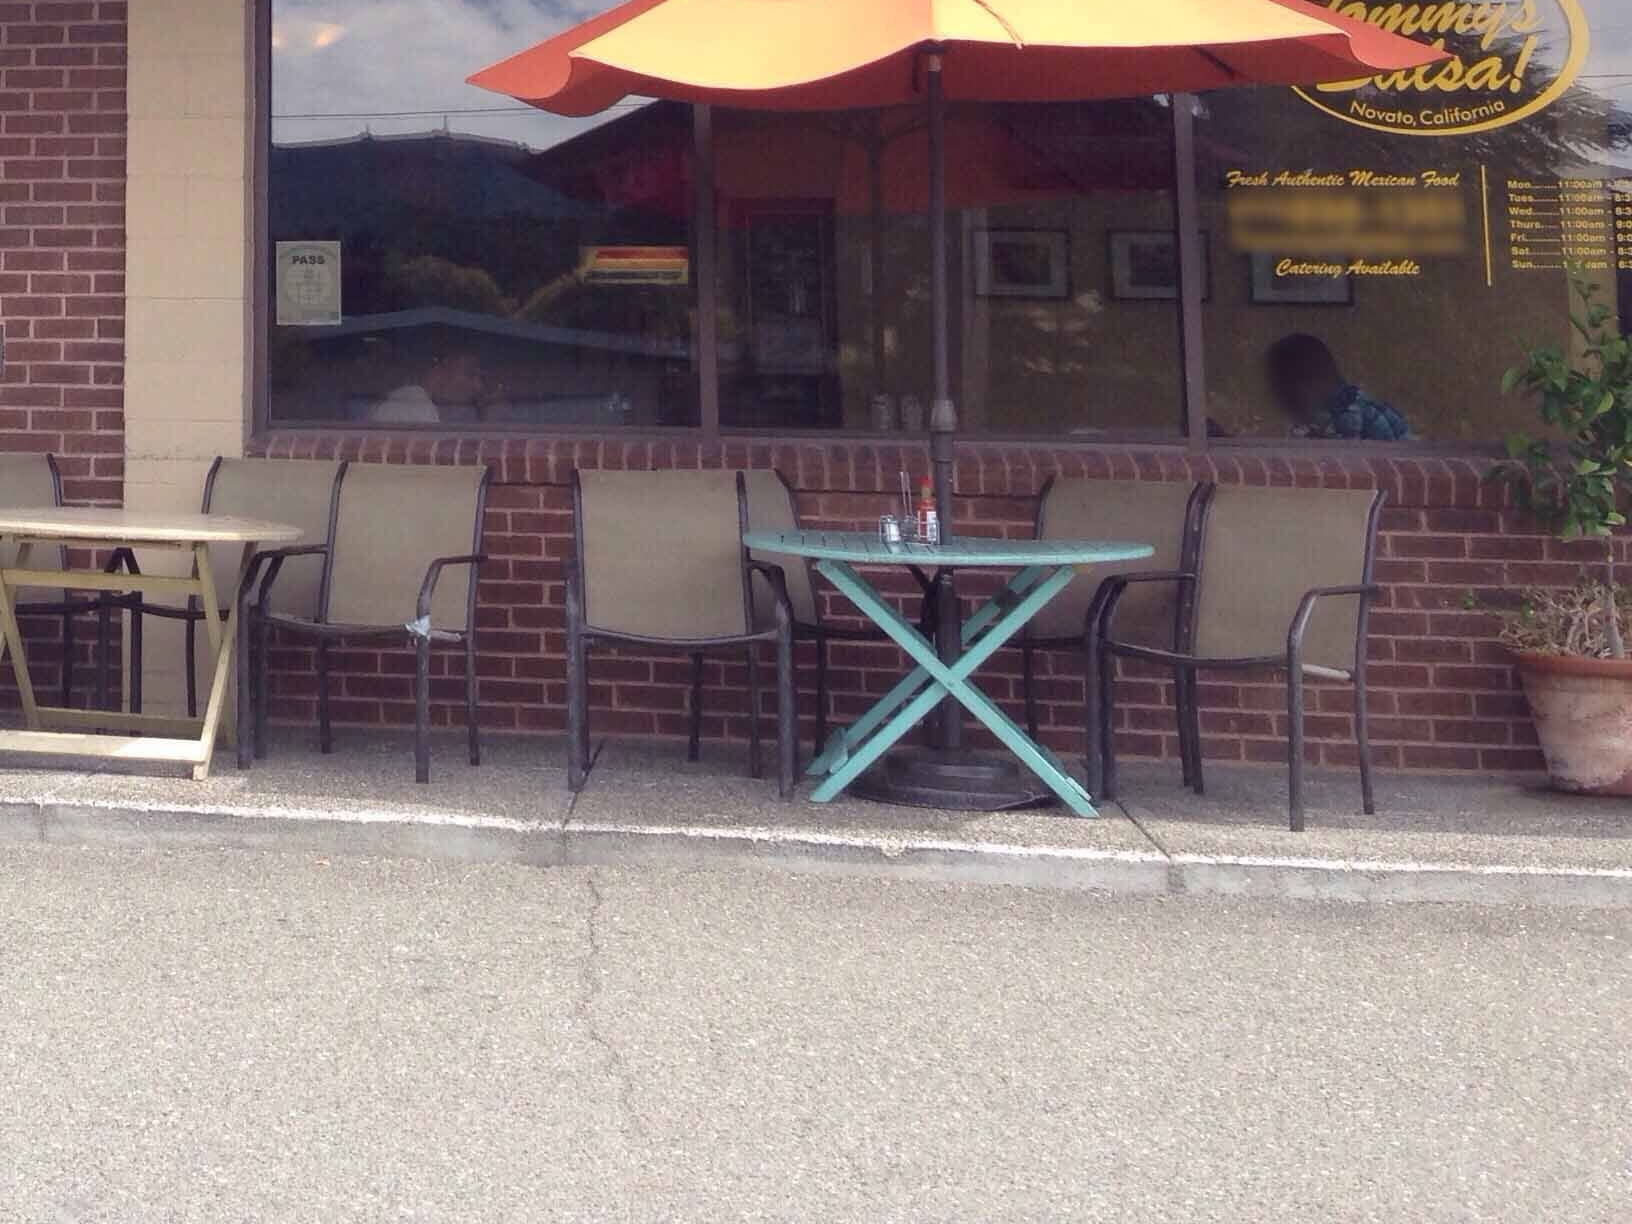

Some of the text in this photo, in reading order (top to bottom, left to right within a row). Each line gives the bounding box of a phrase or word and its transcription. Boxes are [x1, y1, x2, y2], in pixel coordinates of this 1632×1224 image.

[1350, 99, 1505, 127] Novato, California
[1225, 169, 1461, 188] Fresh Authentic Mexican Food
[291, 255, 326, 265] PASS
[1275, 258, 1421, 278] Catering Available
